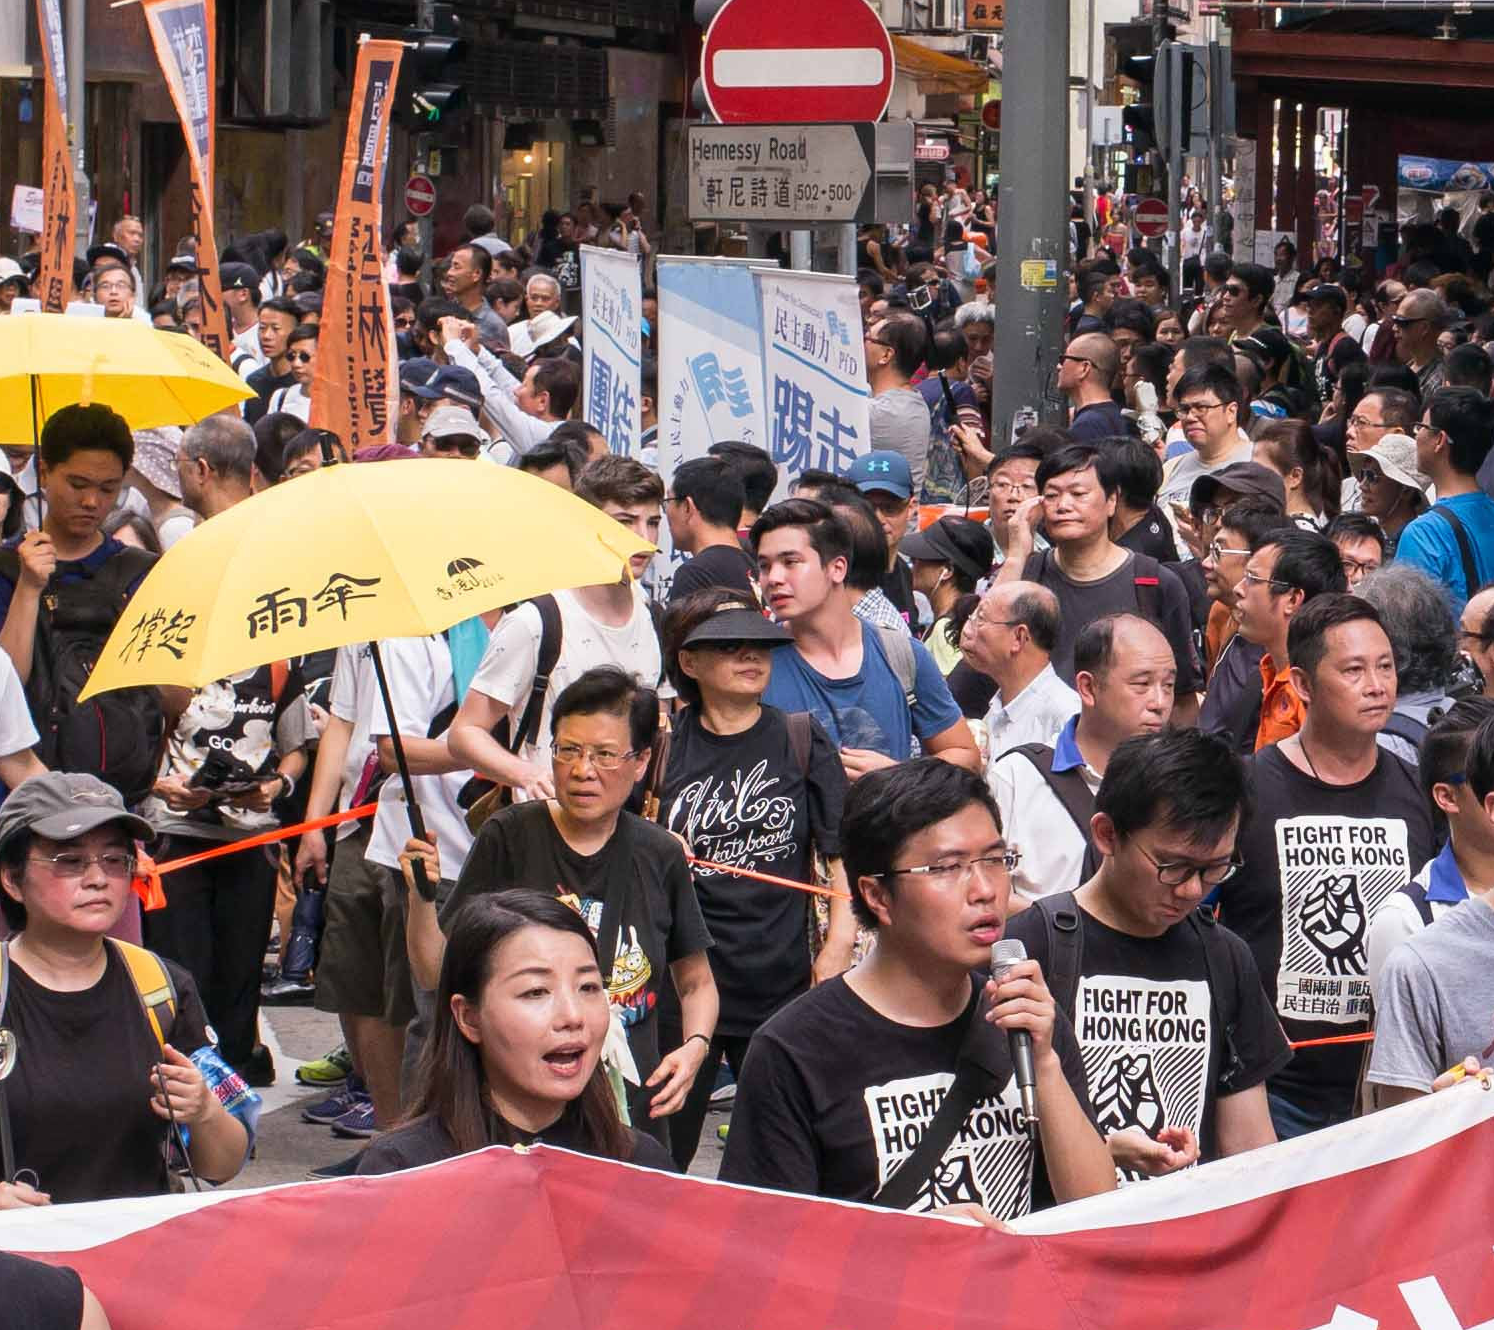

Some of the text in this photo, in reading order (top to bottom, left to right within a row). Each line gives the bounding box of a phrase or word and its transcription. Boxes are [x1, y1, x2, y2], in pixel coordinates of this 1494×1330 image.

[693, 138, 806, 166] Hennessy Road
[706, 176, 792, 208] 軒尼詩道
[774, 307, 830, 364] 民主動力
[839, 351, 858, 377] PfD
[118, 572, 382, 665] 撐起 雨傘
[1284, 826, 1388, 846] FIGHT FOR
[1285, 847, 1405, 867] HONG KONG
[1283, 978, 1343, 997] 一國兩制
[1083, 988, 1188, 1016] FIGHT FOR
[1282, 994, 1340, 1015] 民主自治
[1082, 1016, 1206, 1043] HONG KONG
[959, 1106, 1030, 1142] KONG
